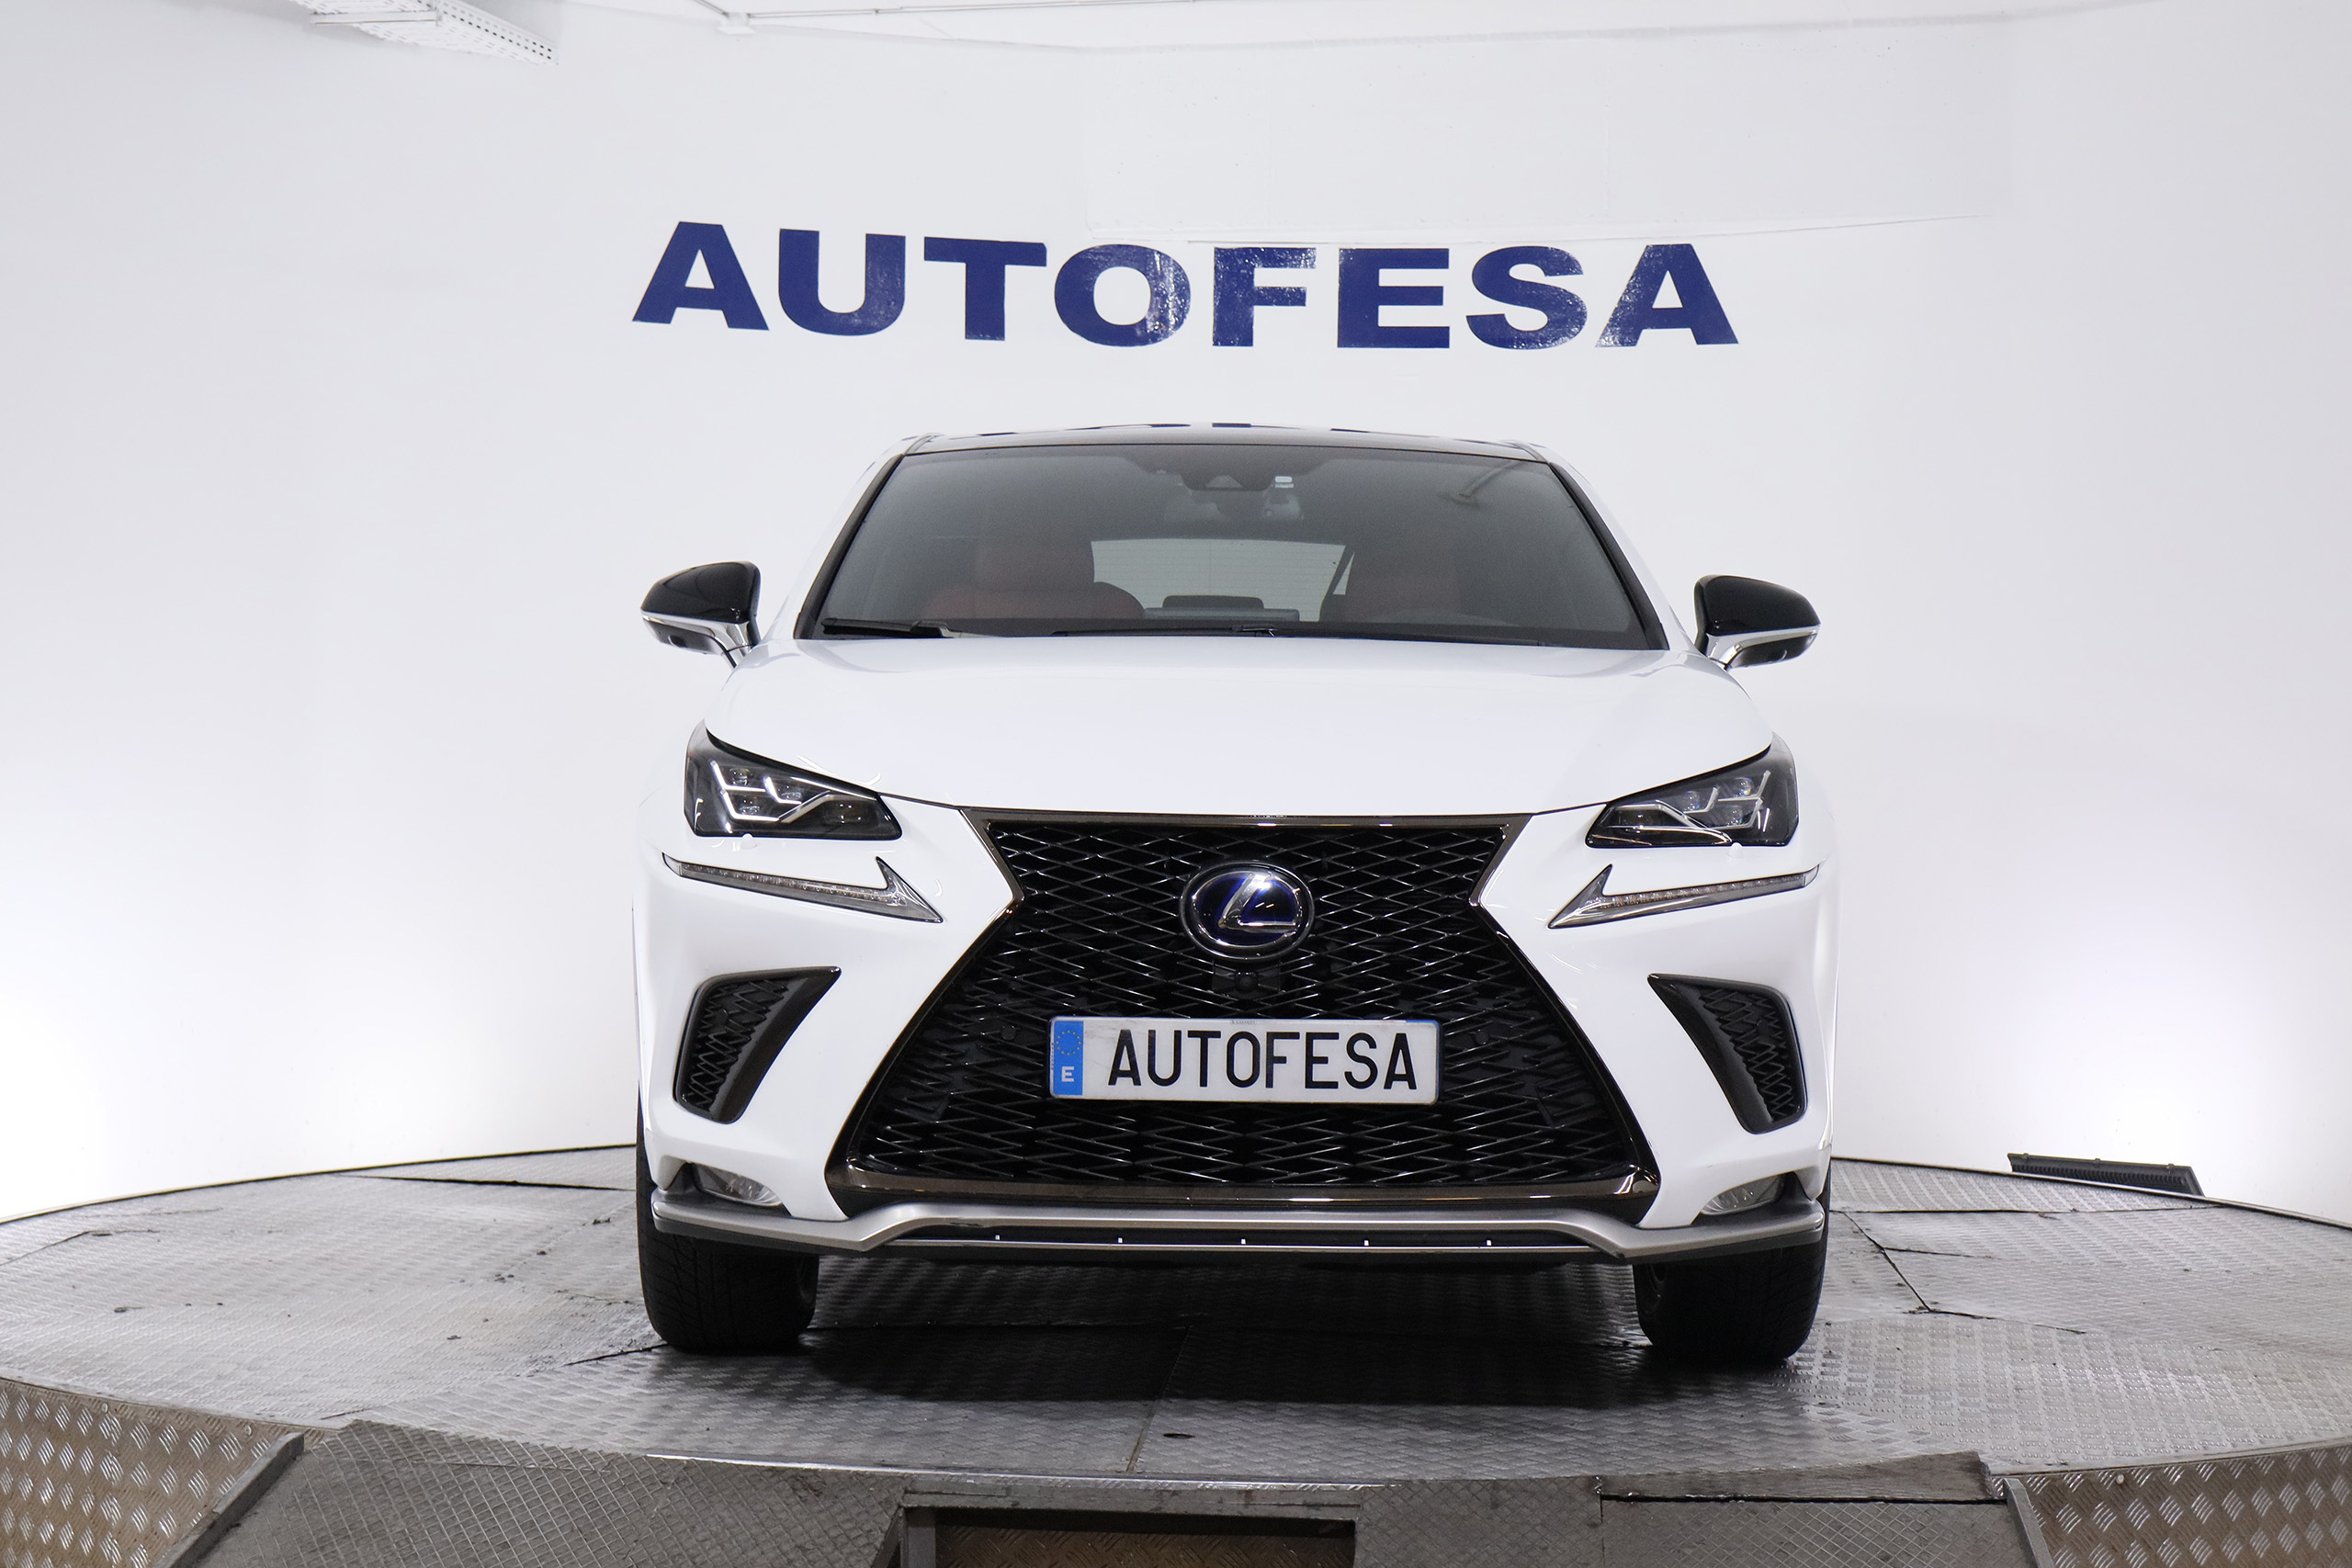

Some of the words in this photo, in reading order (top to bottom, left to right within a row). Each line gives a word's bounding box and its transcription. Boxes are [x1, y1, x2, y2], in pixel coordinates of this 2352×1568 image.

[631, 220, 1739, 349] AUTOFESA
[1061, 1066, 1075, 1082] E
[1107, 1029, 1418, 1090] AUTOFESA
